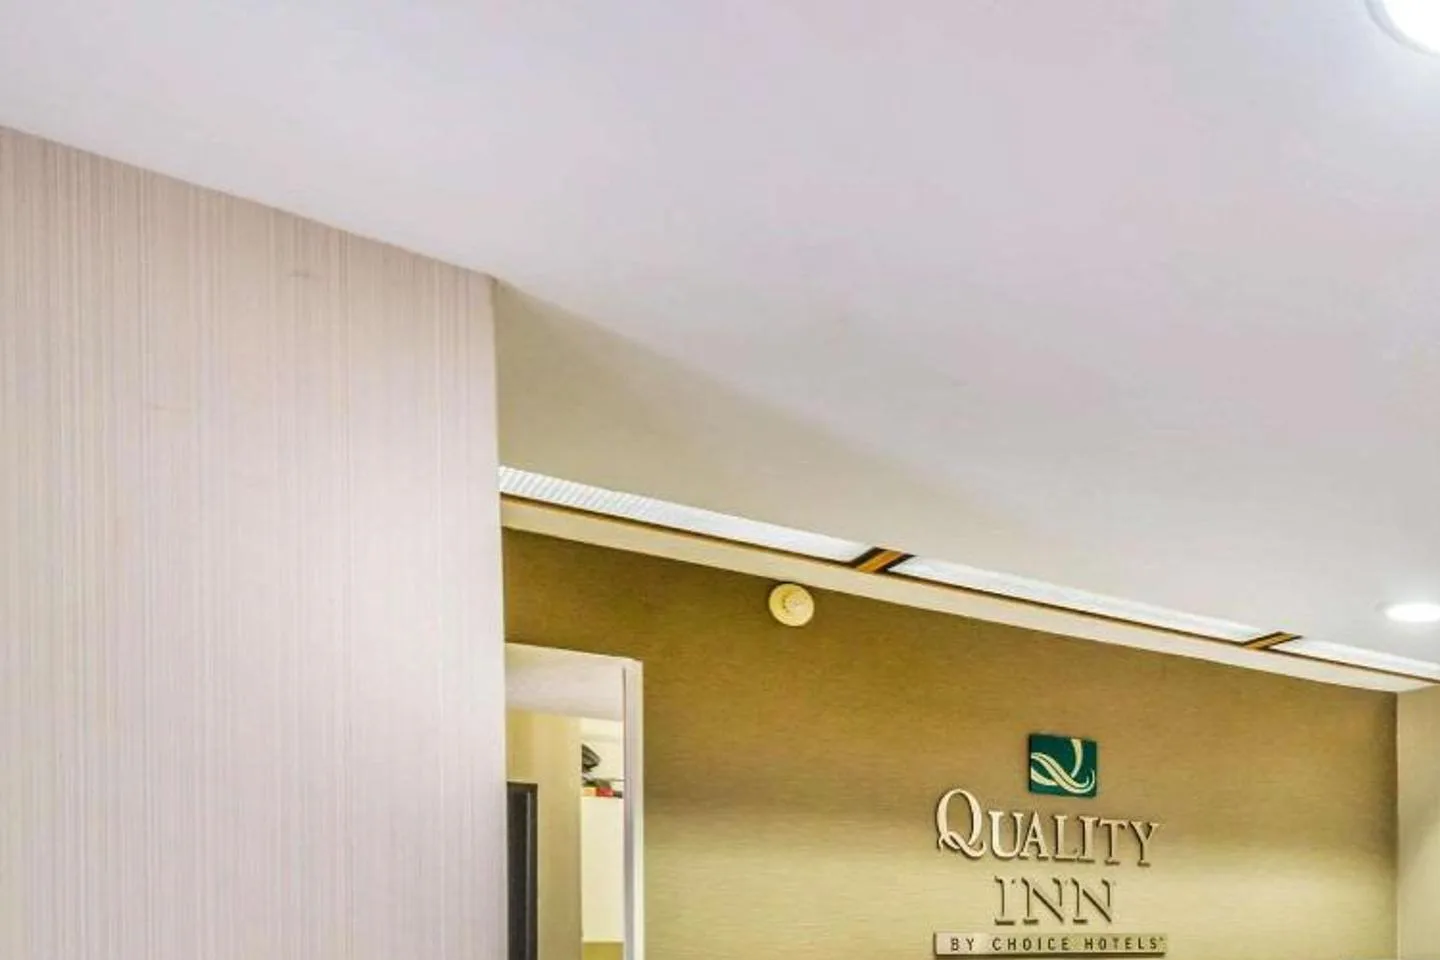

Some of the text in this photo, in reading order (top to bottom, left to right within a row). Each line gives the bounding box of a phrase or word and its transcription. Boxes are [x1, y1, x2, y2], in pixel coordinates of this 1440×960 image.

[936, 788, 1160, 867] QUALITY
[994, 875, 1116, 926] INN
[950, 936, 1158, 951] BY CHOICE HOTELS
